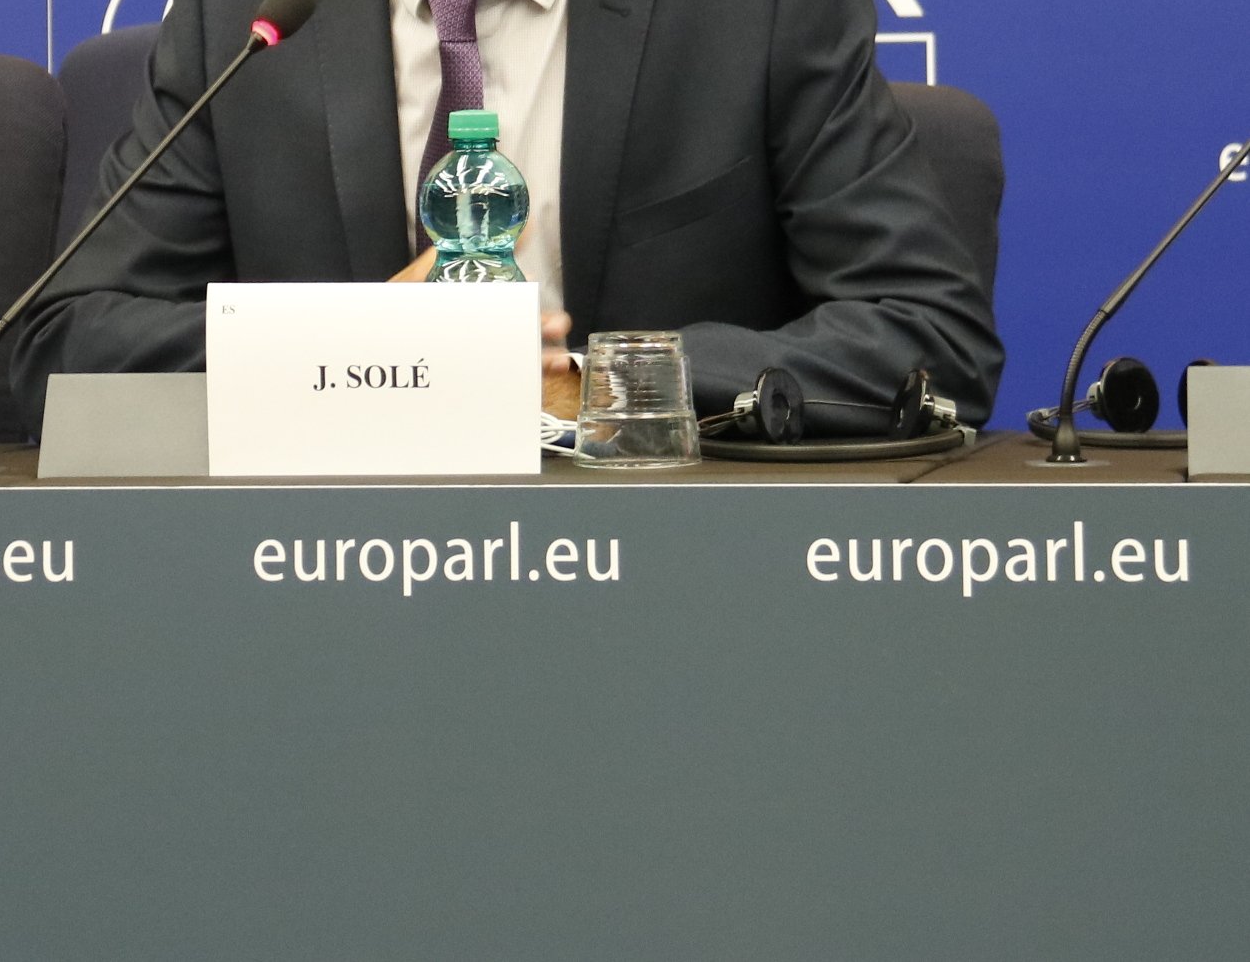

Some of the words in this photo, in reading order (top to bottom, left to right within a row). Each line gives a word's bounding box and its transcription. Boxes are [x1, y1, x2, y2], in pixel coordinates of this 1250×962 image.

[221, 304, 236, 315] ES
[312, 365, 336, 392] J.
[346, 357, 431, 389] SOLÉ
[253, 520, 620, 597] europarl.eu
[806, 520, 1189, 598] europarl.eu
